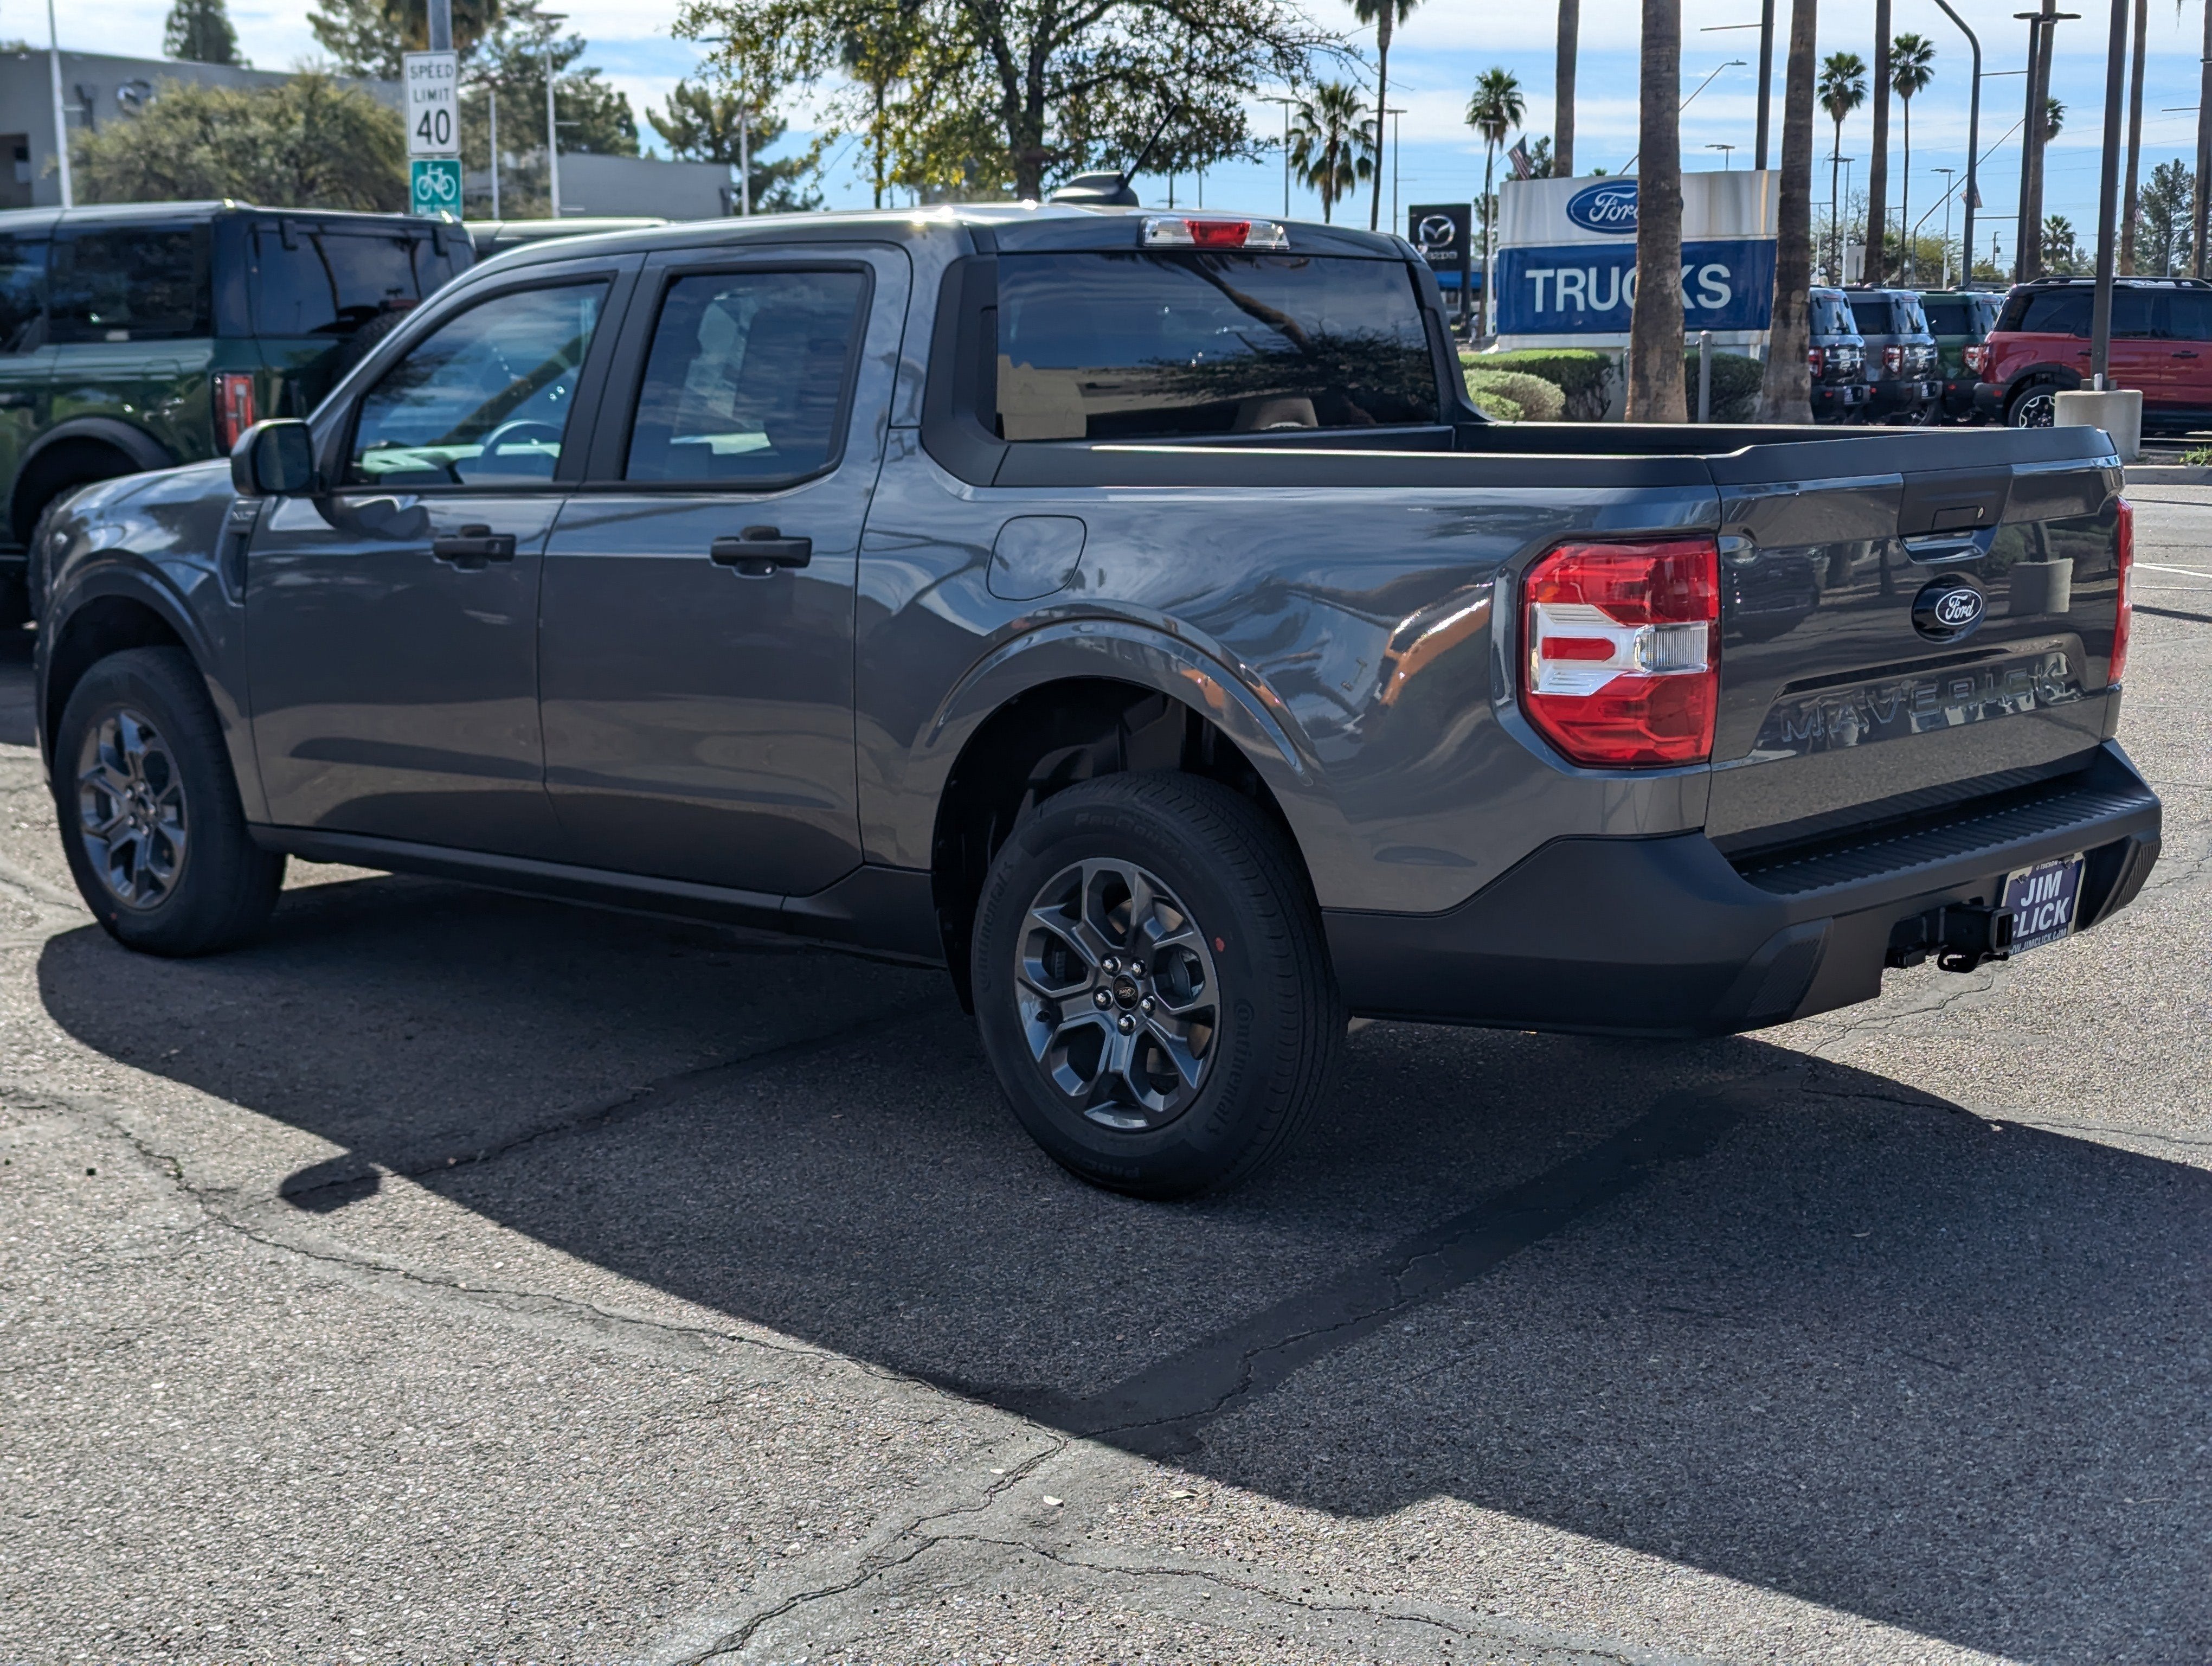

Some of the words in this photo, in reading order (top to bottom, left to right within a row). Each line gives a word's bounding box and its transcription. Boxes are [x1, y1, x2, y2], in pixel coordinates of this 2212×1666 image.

[410, 63, 454, 80] SPEED
[414, 88, 449, 103] LIMIT
[416, 108, 451, 145] 40
[1589, 191, 1638, 222] For
[1945, 595, 1975, 620] Ford
[1780, 661, 2070, 742] MAVERICK
[2021, 870, 2063, 907] JIM
